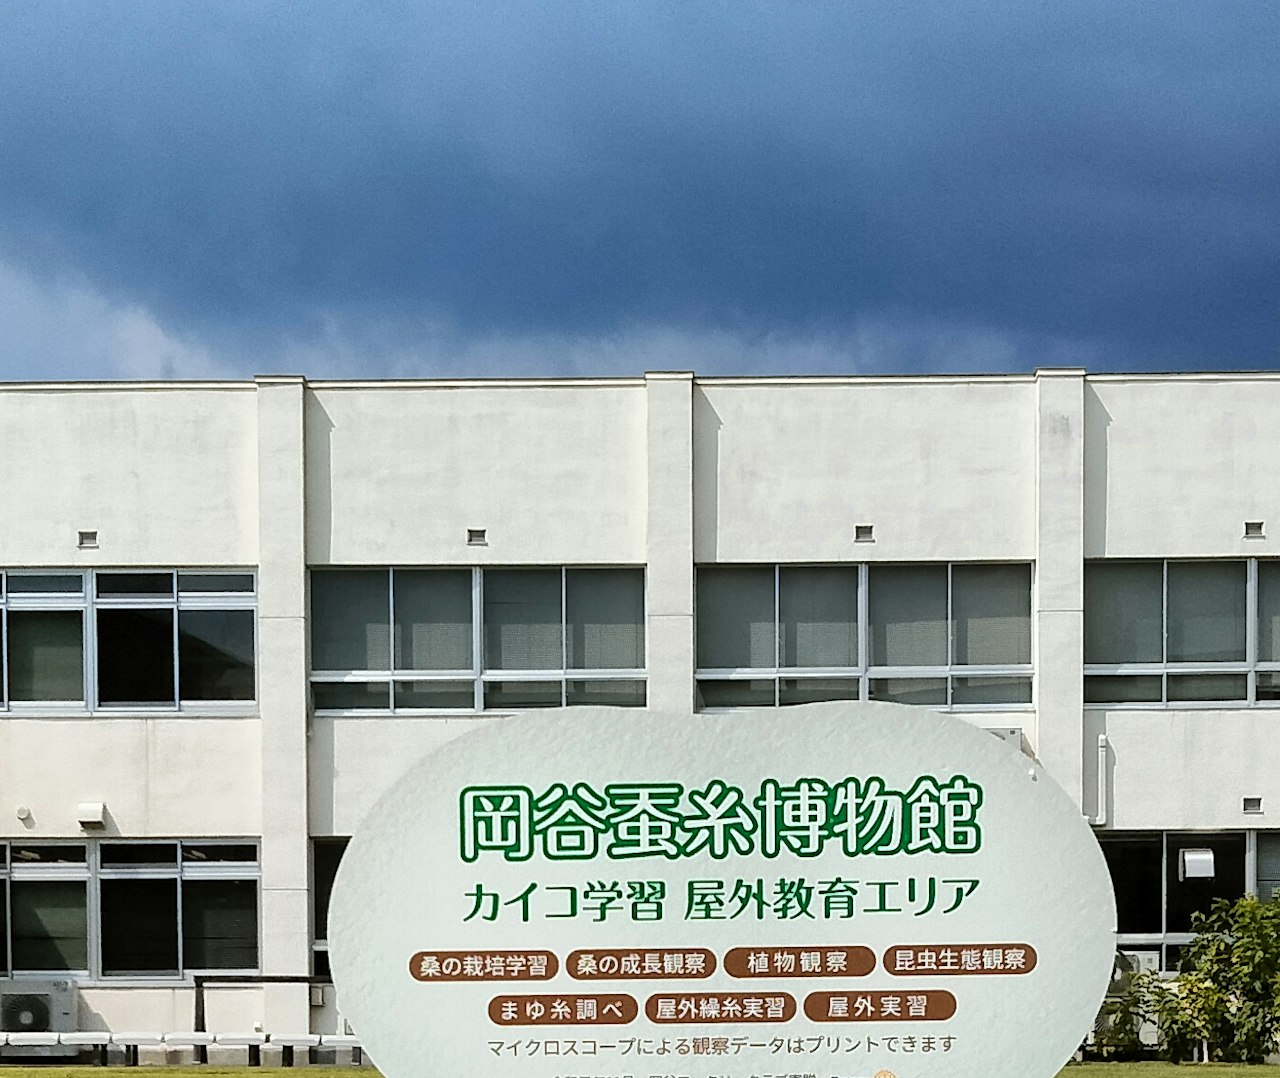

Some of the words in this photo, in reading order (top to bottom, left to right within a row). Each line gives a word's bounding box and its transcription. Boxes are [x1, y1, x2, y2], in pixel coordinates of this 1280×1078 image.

[460, 775, 983, 863] 岡谷蚕糸博物館
[463, 880, 666, 923] カイコ学習
[685, 877, 980, 920] 屋外教育エリア
[420, 954, 548, 978] 桑の栽培学習
[577, 952, 706, 975] 桑の成長観察
[747, 951, 848, 973] 植物観察
[894, 948, 1026, 971] 昆虫生態観察
[500, 998, 623, 1021] まゆ糸調べ
[656, 997, 785, 1019] 屋外繰糸実習
[827, 995, 928, 1017] 屋外実習
[488, 1035, 957, 1057] マイクロスコープによる観察データはプリントできます
